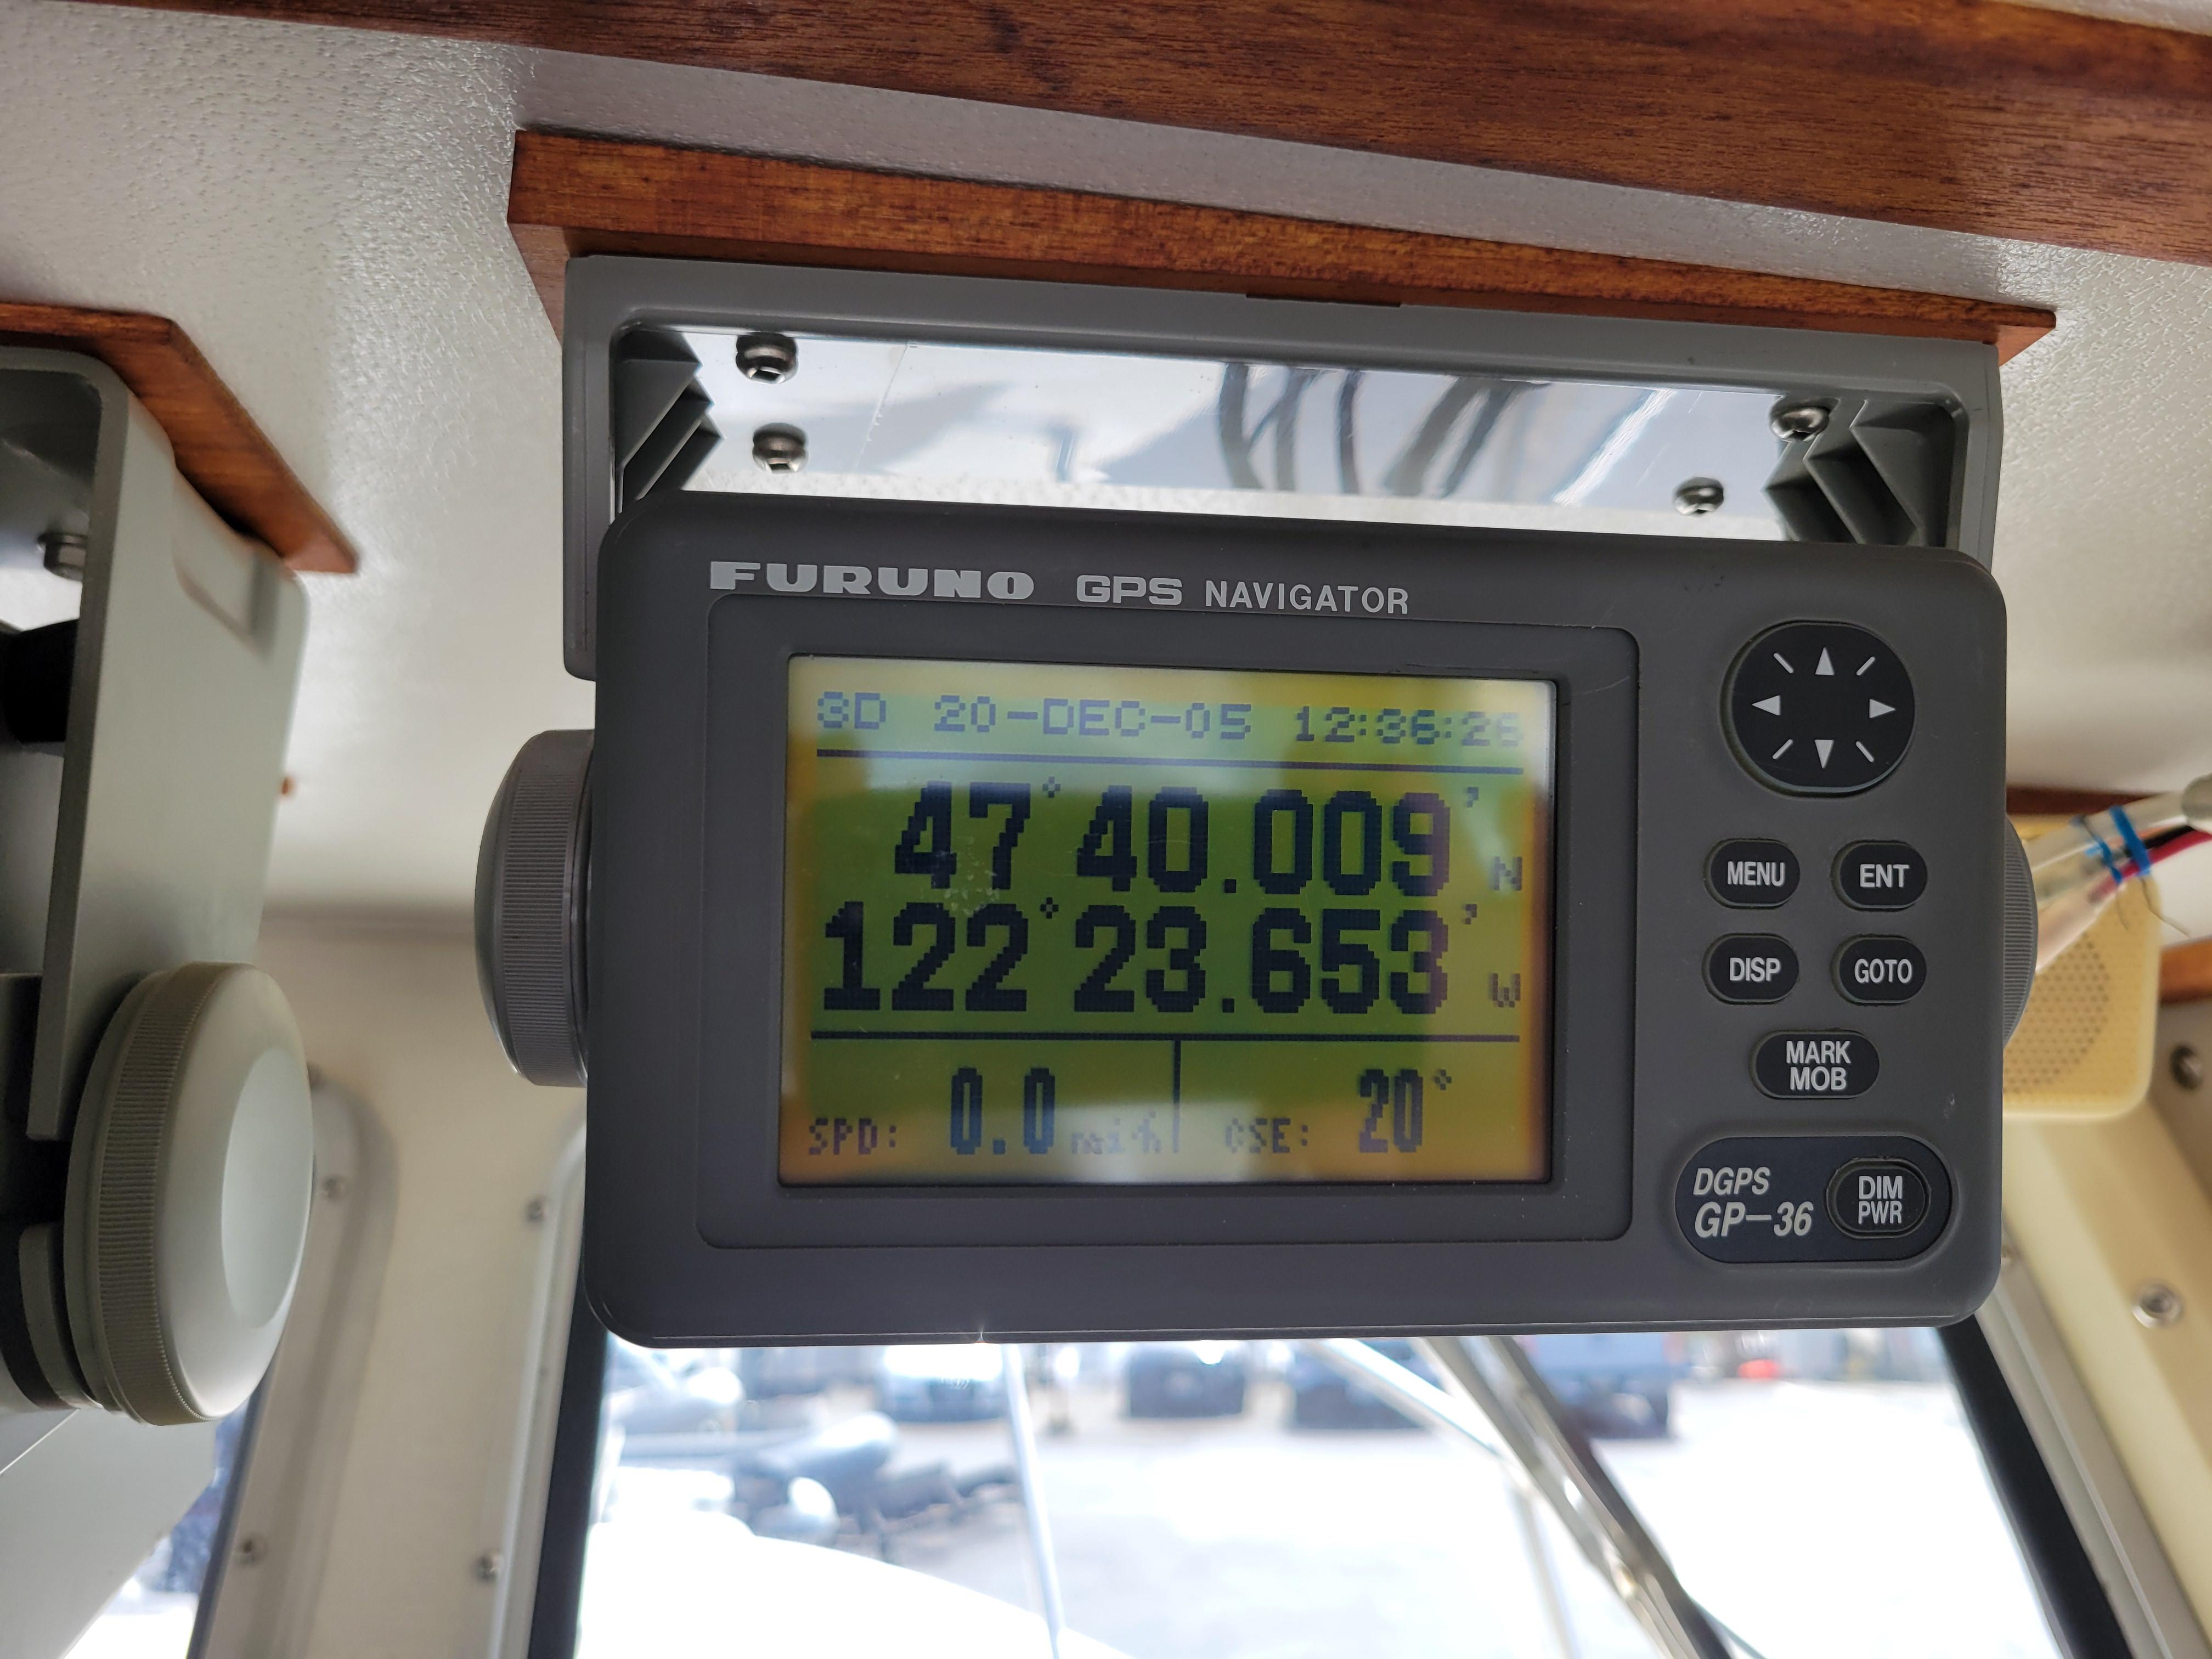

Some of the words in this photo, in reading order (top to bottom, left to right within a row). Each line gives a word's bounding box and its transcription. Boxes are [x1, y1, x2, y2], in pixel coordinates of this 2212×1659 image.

[710, 561, 1035, 600] FURUNO
[1076, 574, 1183, 606] GPS
[1205, 580, 1409, 615] NAVIGATOR
[817, 691, 887, 730] 3D
[933, 695, 1251, 740] 20-DEC-05
[1492, 856, 1523, 892] N
[1727, 861, 1786, 887] MENU
[1859, 864, 1910, 888] ENT
[1729, 957, 1781, 982] DISP
[1854, 959, 1913, 984] GOTO
[1487, 972, 1521, 1007] W
[1786, 1040, 1852, 1065] MARK
[1789, 1066, 1847, 1091] MOB
[809, 1118, 899, 1156] SPD:
[950, 1066, 1056, 1155] 0.0
[1224, 1116, 1308, 1154] CSE:
[1692, 1166, 1771, 1197] DGPS
[1858, 1176, 1903, 1200] DIM
[1694, 1200, 1814, 1238] GP-36
[1858, 1201, 1903, 1224] PWR
